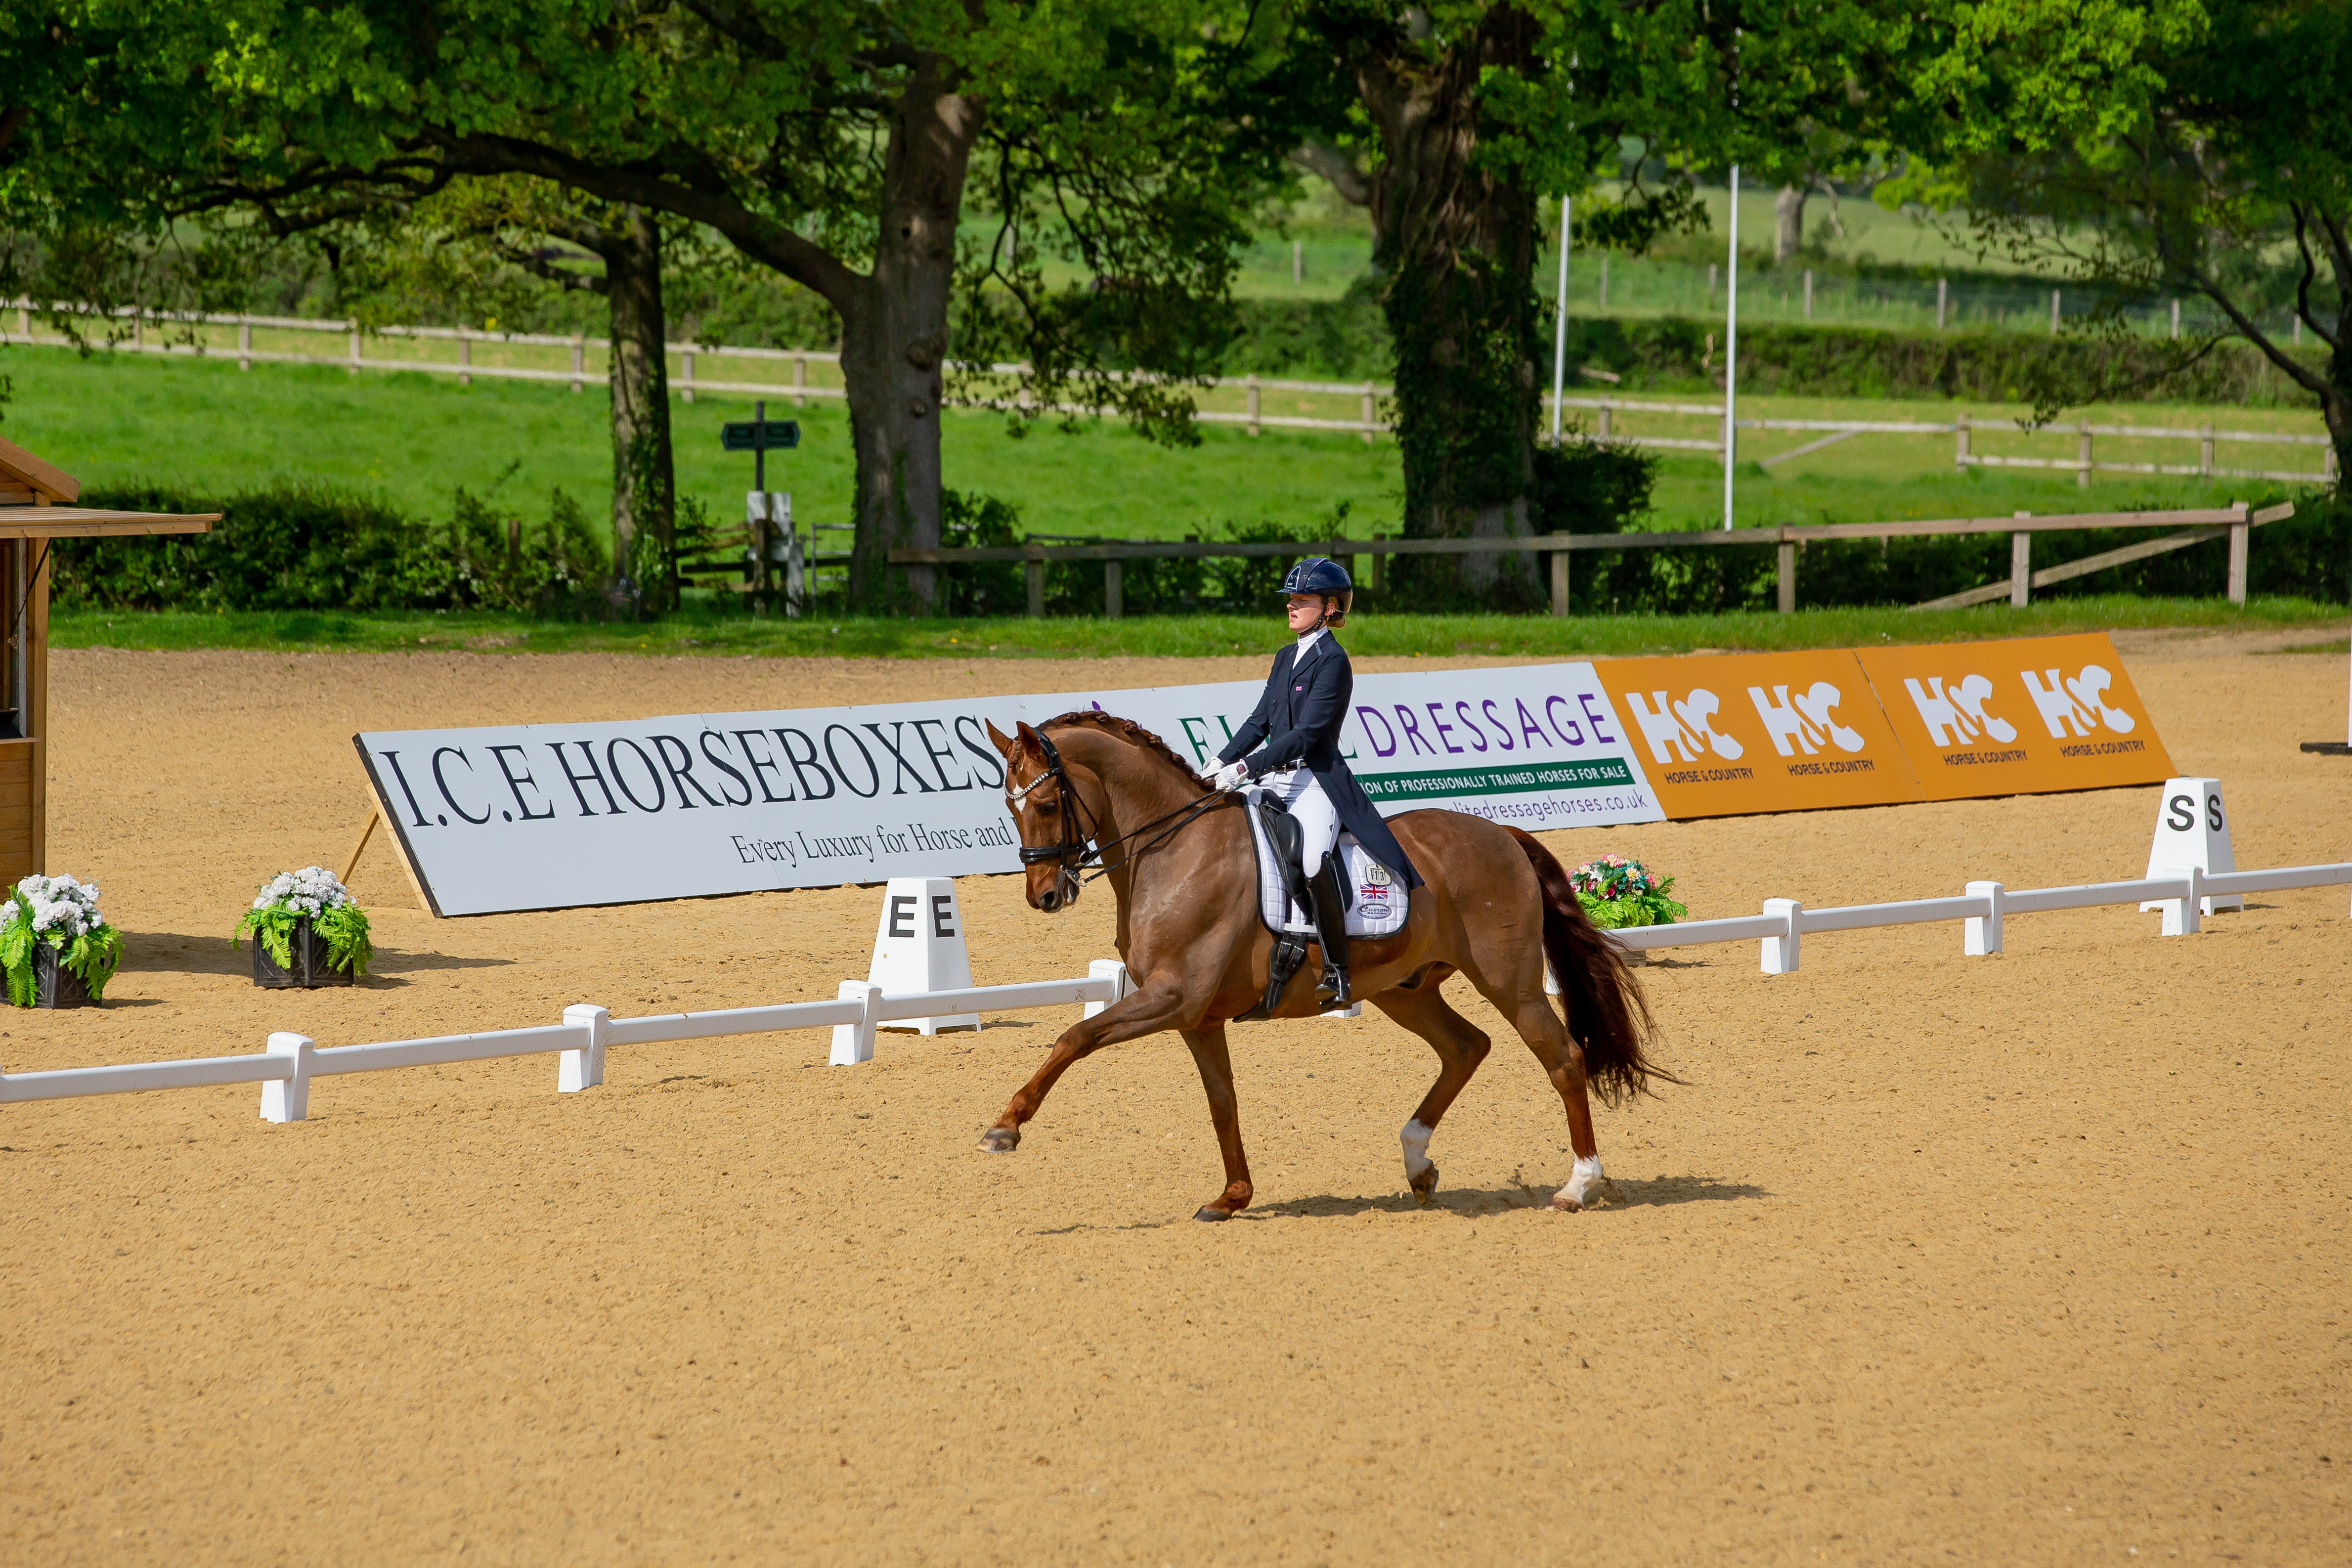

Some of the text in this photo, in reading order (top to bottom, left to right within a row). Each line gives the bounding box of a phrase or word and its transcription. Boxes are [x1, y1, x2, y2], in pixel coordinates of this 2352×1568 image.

[1747, 681, 1865, 756] H&C
[1904, 674, 2017, 747] H&C
[2020, 664, 2135, 739] H&C
[1355, 693, 1615, 758] DRESSAGE
[1625, 688, 1744, 764] H&C
[1787, 763, 1823, 776] HORSE
[1829, 759, 1875, 773] COUNTRY
[1943, 753, 1978, 766] HORSE
[1984, 749, 2028, 764] COUNTRY
[2059, 744, 2095, 757] HORSE
[2100, 740, 2145, 754] COUNTRY
[378, 715, 1004, 827] I.C.E HORSEBOXES
[1358, 765, 1627, 794] ION OF PROFESSIONALLY TRAINED HORSES FOR SALE
[1664, 770, 1701, 784] HORSE
[1707, 767, 1754, 782] COUNTRY
[1448, 788, 1649, 822] litedressagehorses.co.uk
[2167, 794, 2195, 832] S
[2207, 794, 2224, 832] S
[729, 835, 797, 869] Every
[794, 831, 874, 863] Luxury
[876, 825, 910, 854] for
[906, 824, 973, 851] Horse
[975, 817, 1015, 847] and
[889, 895, 917, 938] E
[931, 895, 956, 938] E
